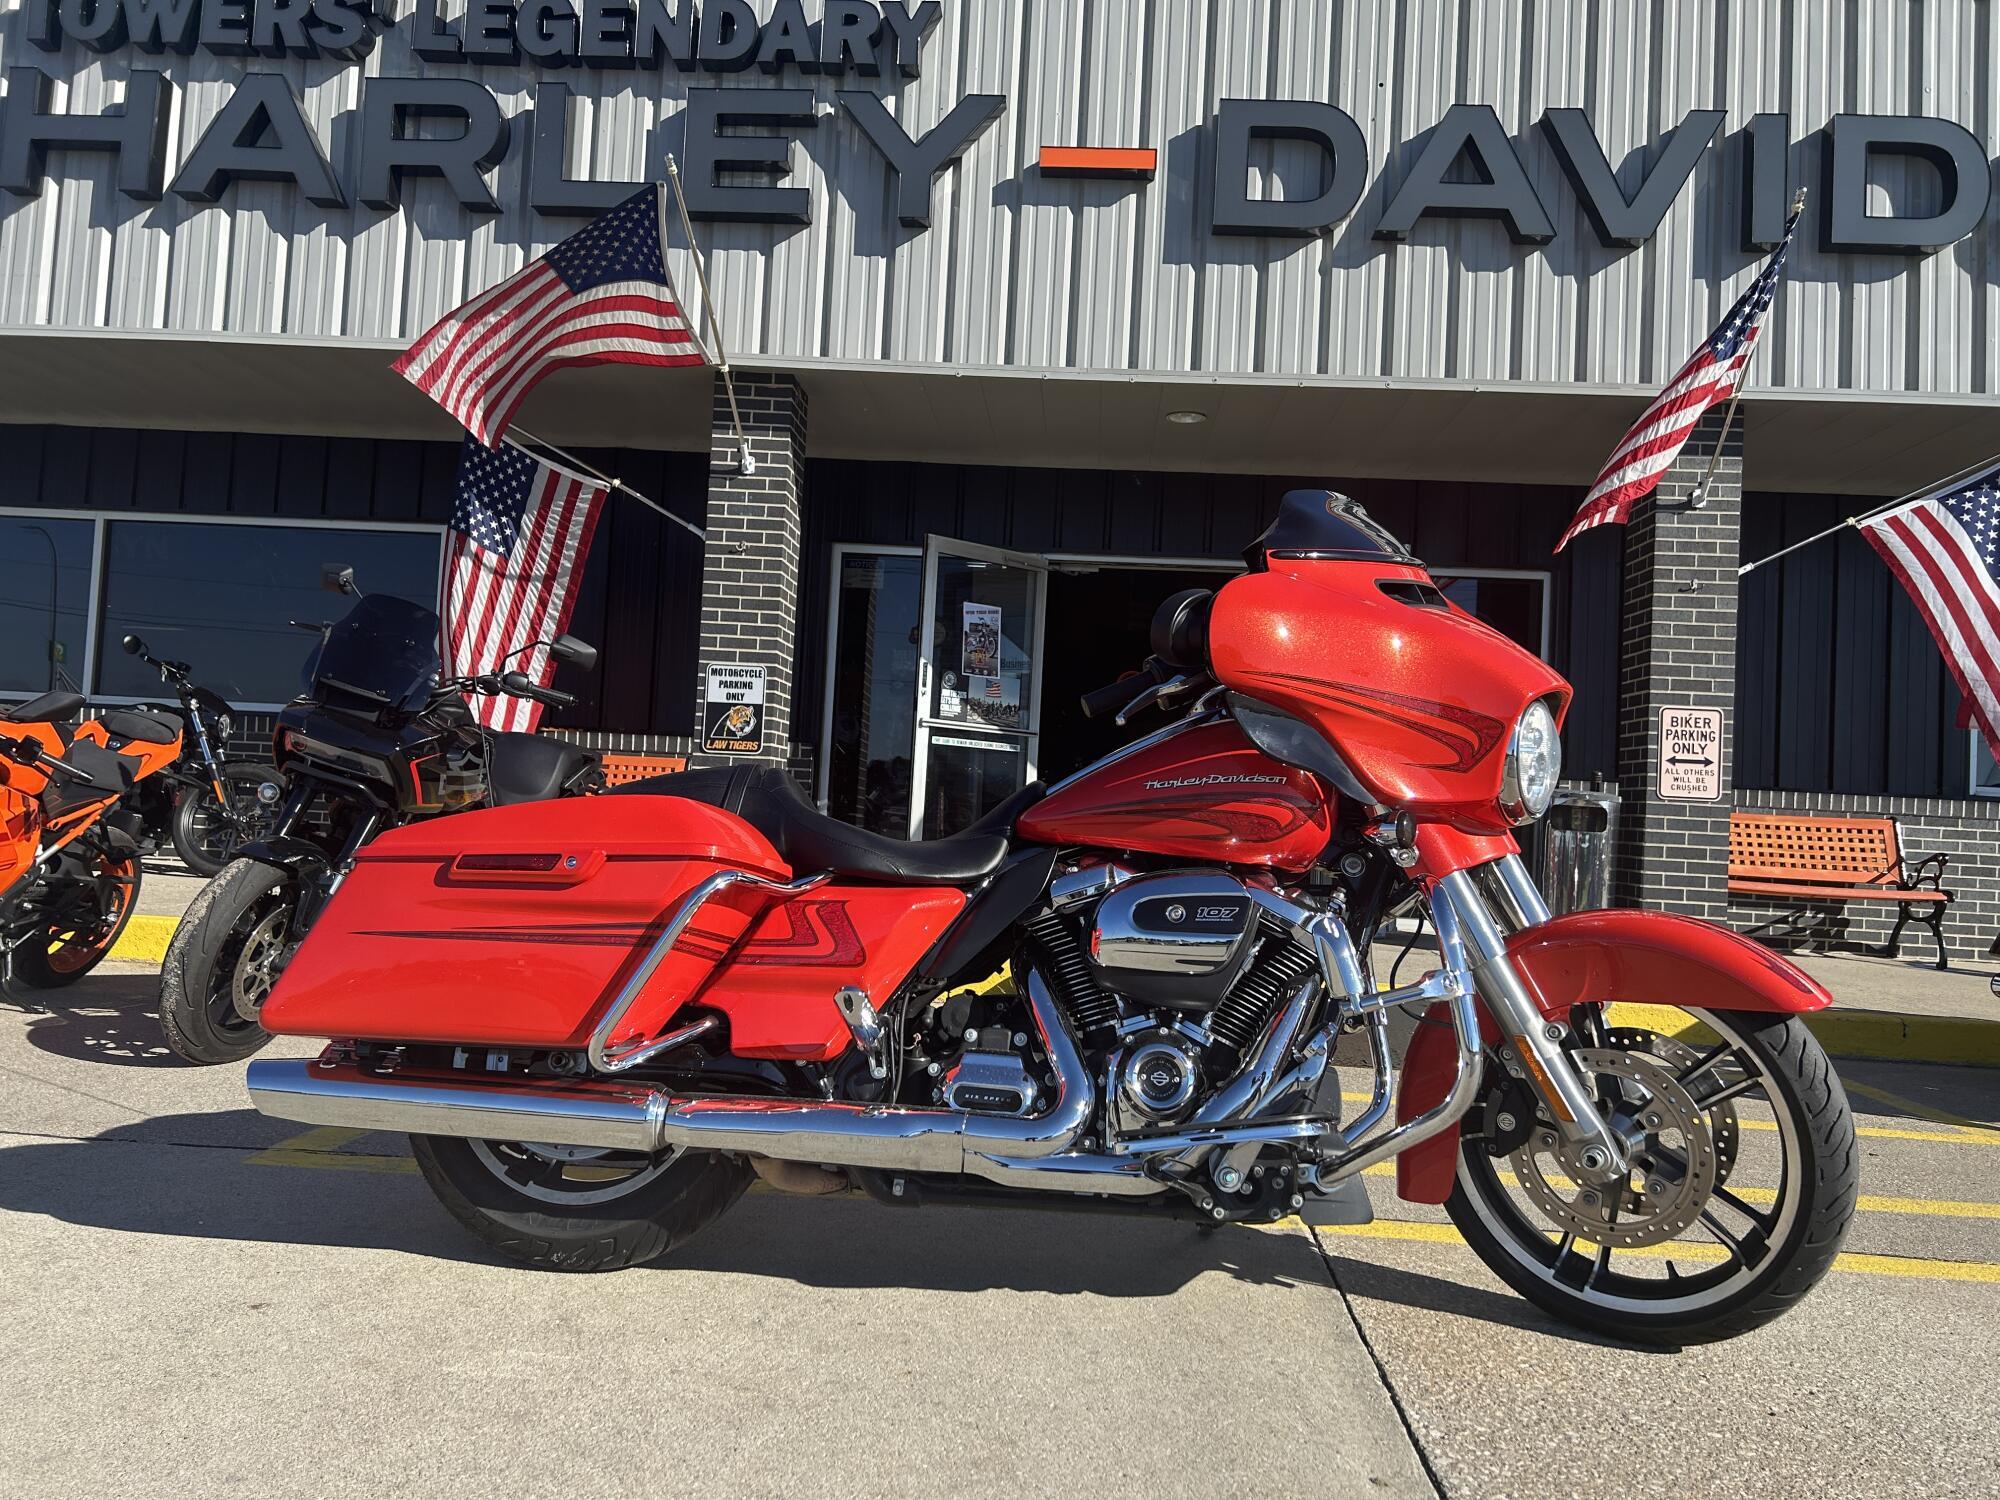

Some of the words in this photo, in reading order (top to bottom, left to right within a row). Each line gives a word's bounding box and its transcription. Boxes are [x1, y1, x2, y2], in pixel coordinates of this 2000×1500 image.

[410, 0, 942, 78] LEGENDARY
[0, 66, 1006, 229] HARLEY
[1211, 98, 1991, 256] DAVID
[710, 667, 763, 679] MOTORCYCLE
[718, 680, 753, 690] PARKING
[726, 692, 745, 702] ONLY
[1670, 715, 1712, 729] BIKER
[1665, 729, 1716, 742] PARKING
[706, 739, 728, 749] LAW
[729, 740, 759, 751] TIGERS
[1672, 742, 1708, 755] ONLY
[1665, 767, 1680, 775] ALL
[1684, 768, 1715, 777] OTHERS
[1144, 773, 1287, 790] Harley-Davidson
[1671, 784, 1708, 792] CRUSHED
[1197, 906, 1240, 918] 107
